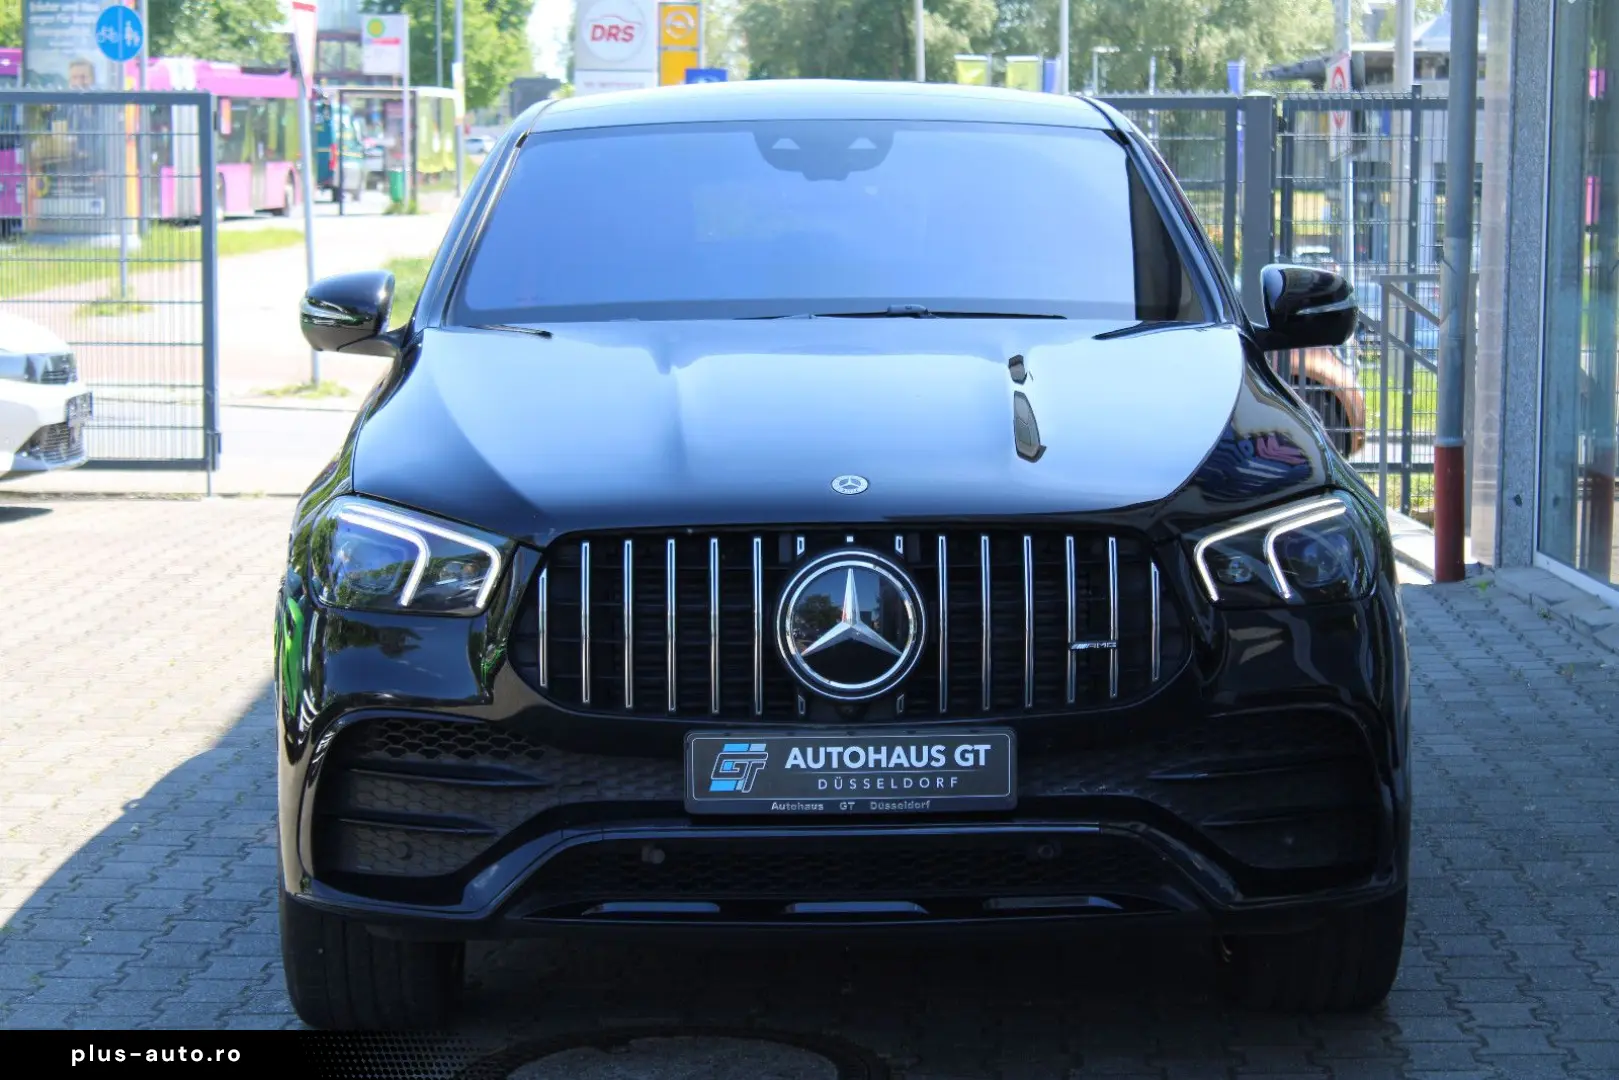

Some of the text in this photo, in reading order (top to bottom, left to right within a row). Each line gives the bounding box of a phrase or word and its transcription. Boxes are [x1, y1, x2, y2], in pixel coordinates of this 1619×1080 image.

[591, 24, 635, 42] DRS
[785, 745, 991, 769] AUTOHAUS GT
[818, 776, 959, 790] DÜSSELDORF
[771, 801, 931, 812] Autohaus GT Düsseldorf
